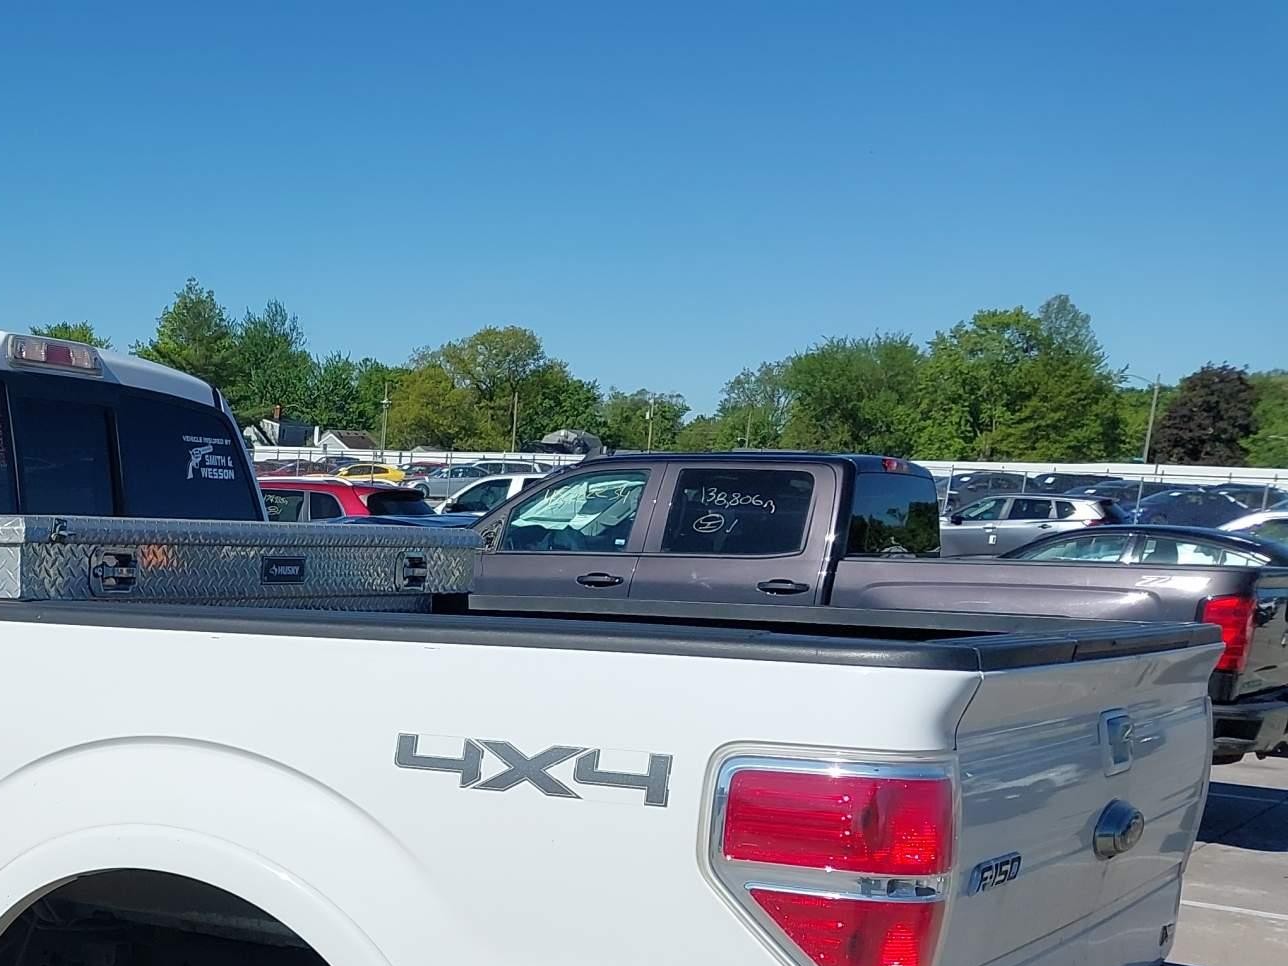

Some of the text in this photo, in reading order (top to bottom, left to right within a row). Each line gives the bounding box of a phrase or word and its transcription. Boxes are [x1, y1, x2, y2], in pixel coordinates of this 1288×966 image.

[181, 435, 203, 443] VEHICLE
[205, 455, 234, 467] SMITH &
[200, 467, 235, 480] WESSON
[276, 565, 300, 576] HUSKY
[394, 732, 673, 807] 4X4
